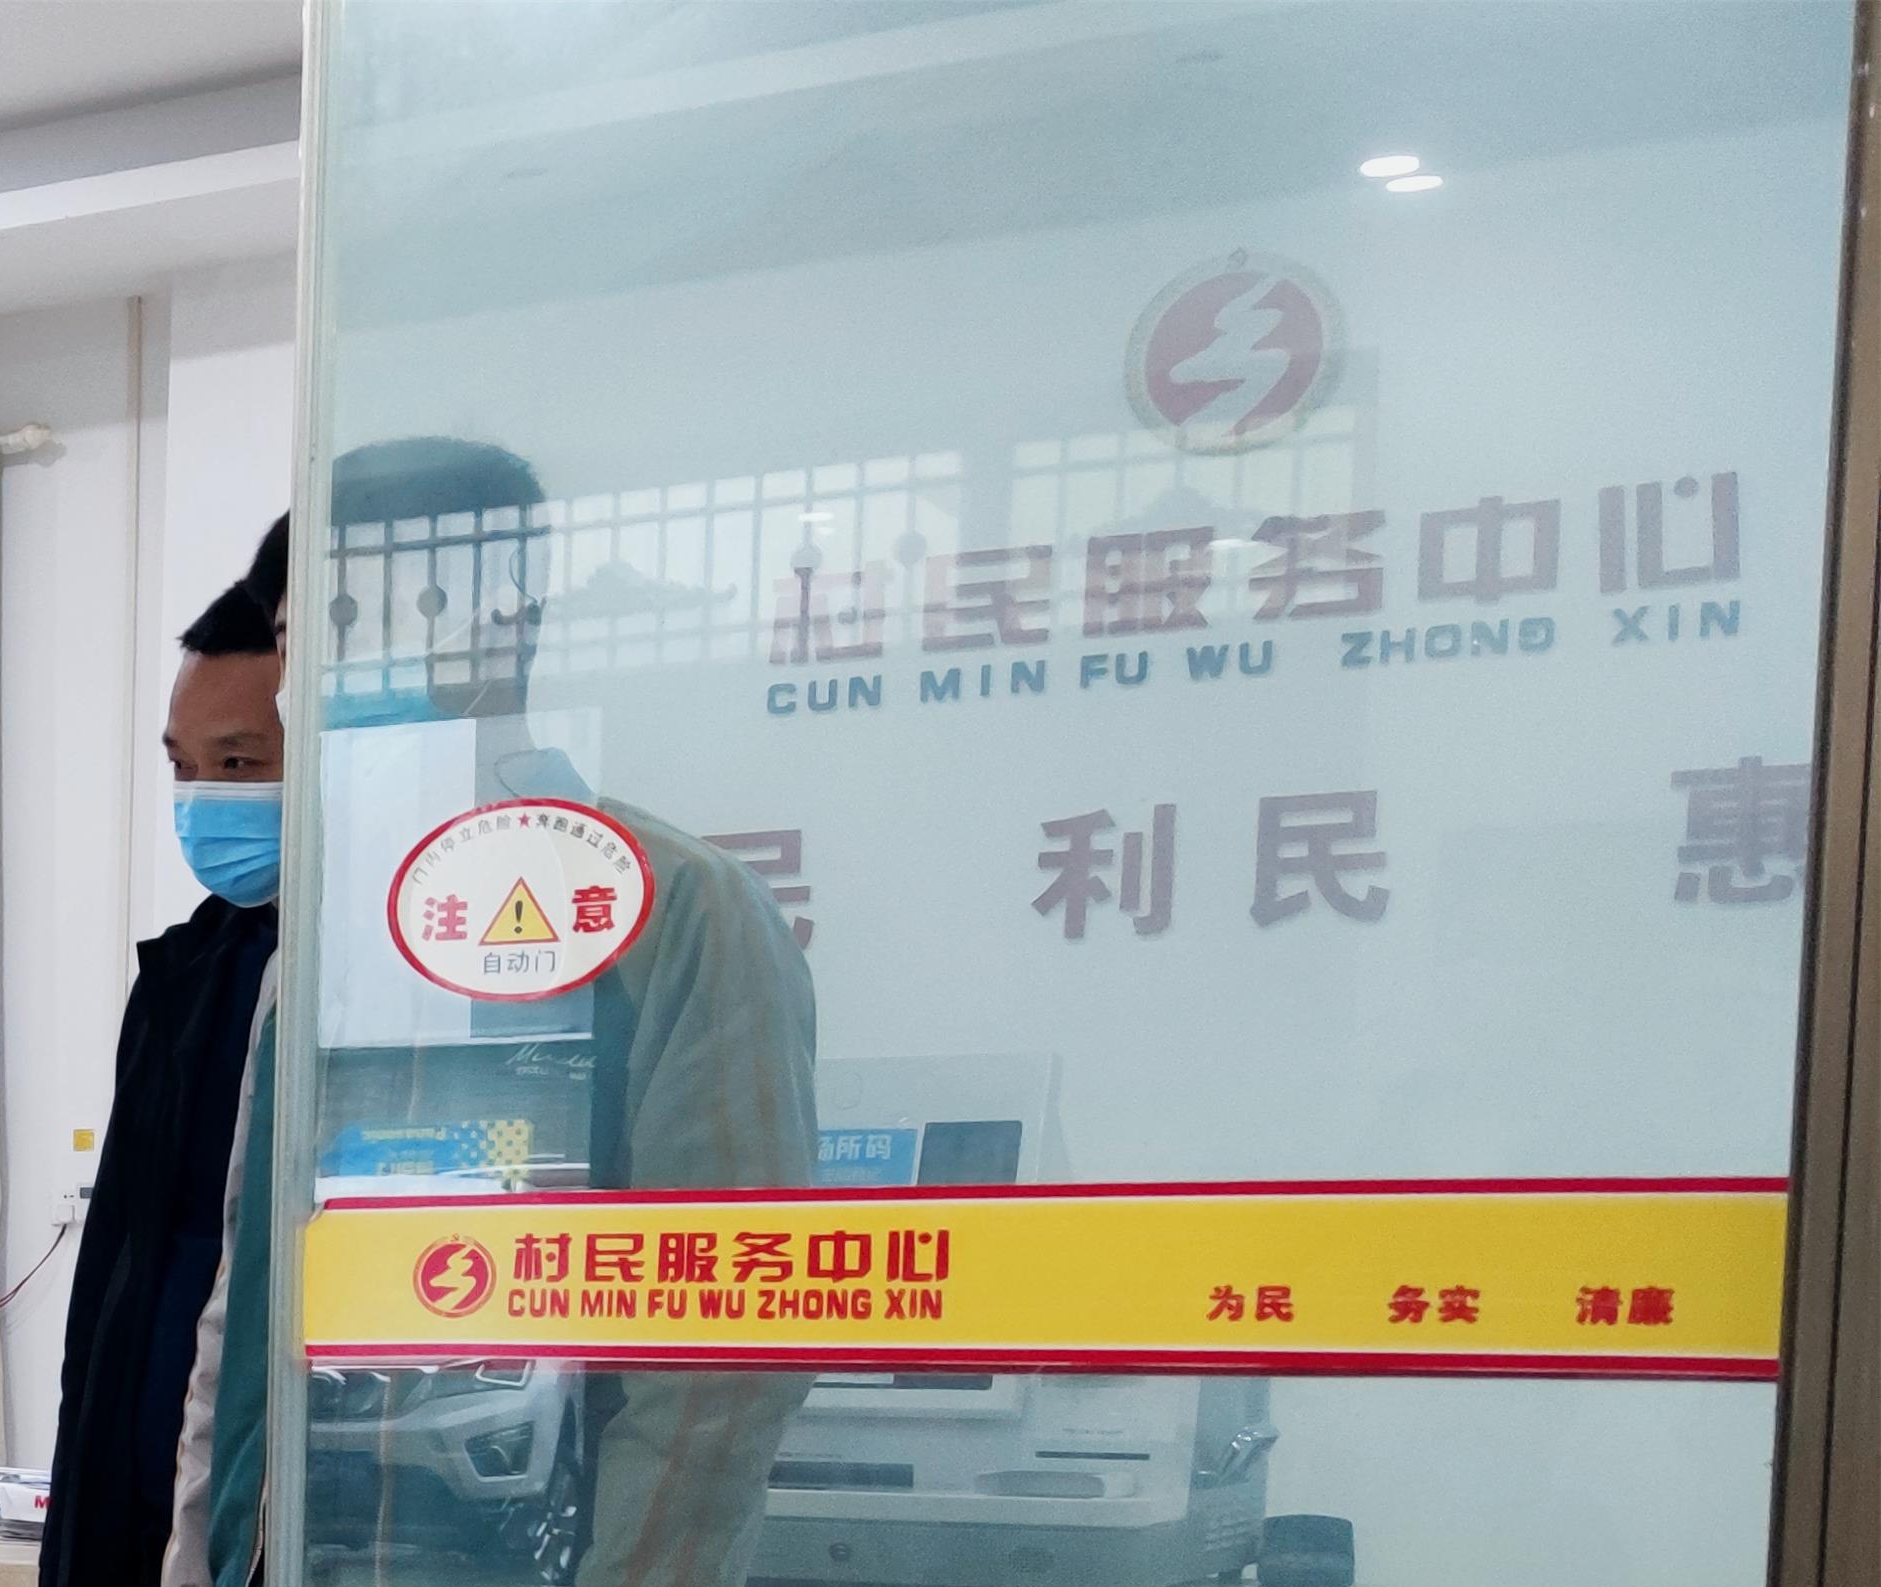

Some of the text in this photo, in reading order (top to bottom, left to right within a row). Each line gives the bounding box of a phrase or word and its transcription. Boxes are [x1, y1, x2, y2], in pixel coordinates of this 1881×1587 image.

[769, 471, 1741, 664] 村民服务中心
[766, 674, 882, 715] CUN
[919, 659, 1046, 703] MIN
[1079, 650, 1148, 688] FU
[1187, 640, 1273, 680] WU
[1611, 600, 1741, 645] XIN
[1031, 790, 1391, 940] 利民
[483, 950, 557, 975] 自动门
[514, 1229, 950, 1284] 村民服务中心
[508, 1288, 942, 1320] CUN MIN FU WU ZHONG XIN
[1206, 1285, 1674, 1326] 为民 务实 清廉
